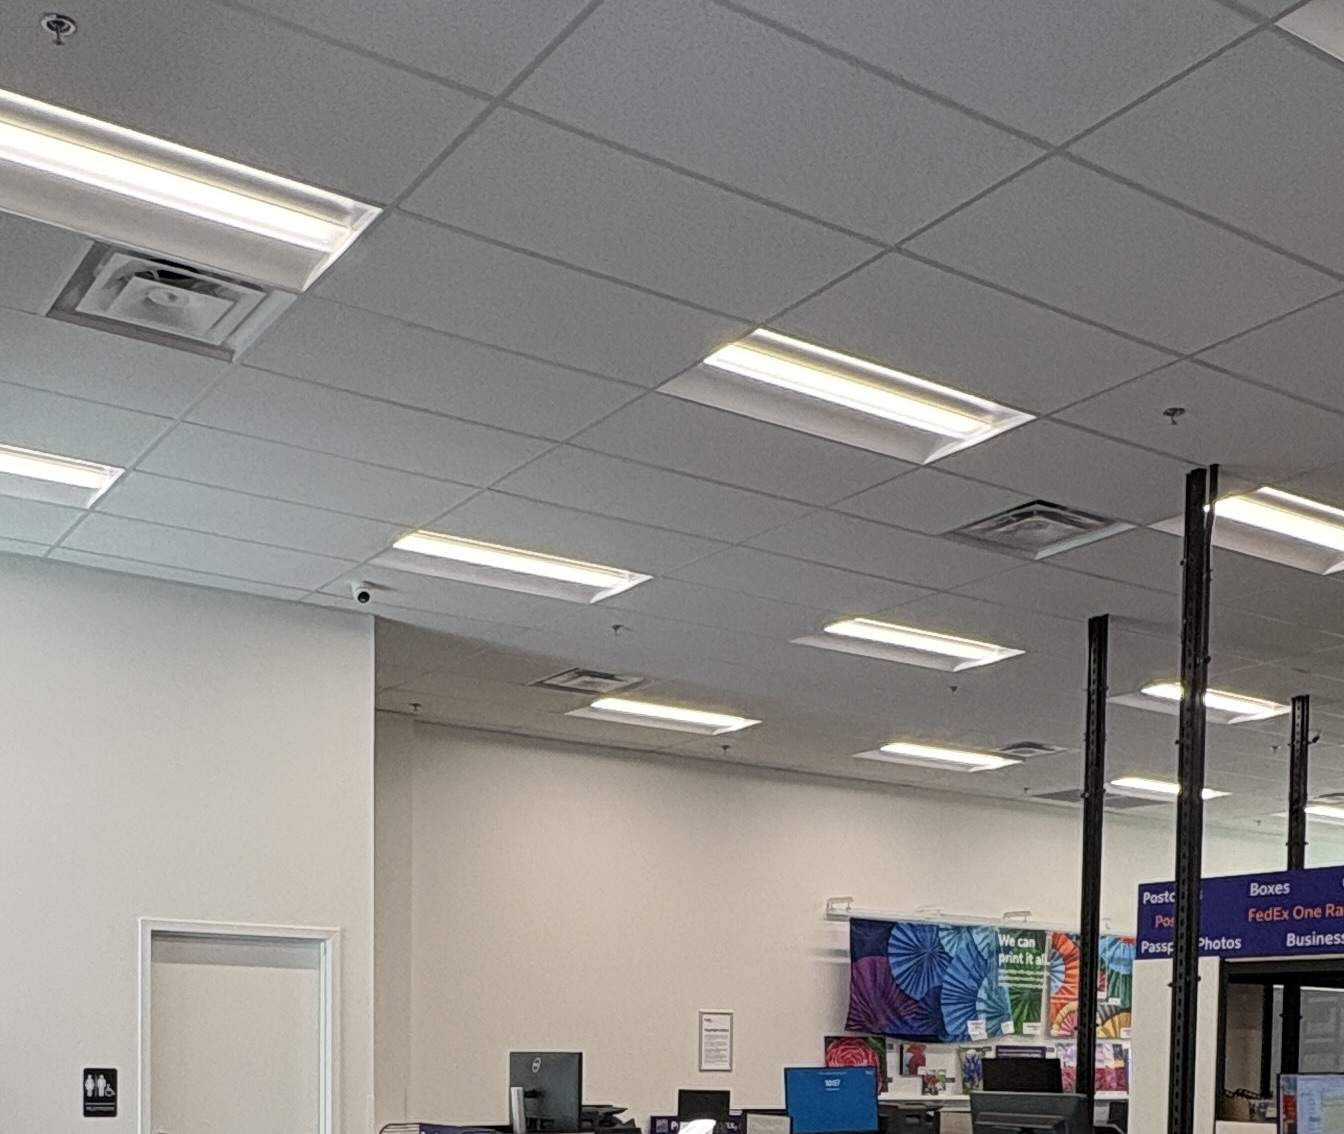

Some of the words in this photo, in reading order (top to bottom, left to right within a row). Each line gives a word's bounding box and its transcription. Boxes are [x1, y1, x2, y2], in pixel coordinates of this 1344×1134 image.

[1249, 882, 1290, 898] Boxes
[1248, 906, 1289, 923] FedEx
[1292, 905, 1322, 920] One
[998, 934, 1015, 947] We
[1017, 938, 1035, 948] can
[999, 951, 1024, 966] print
